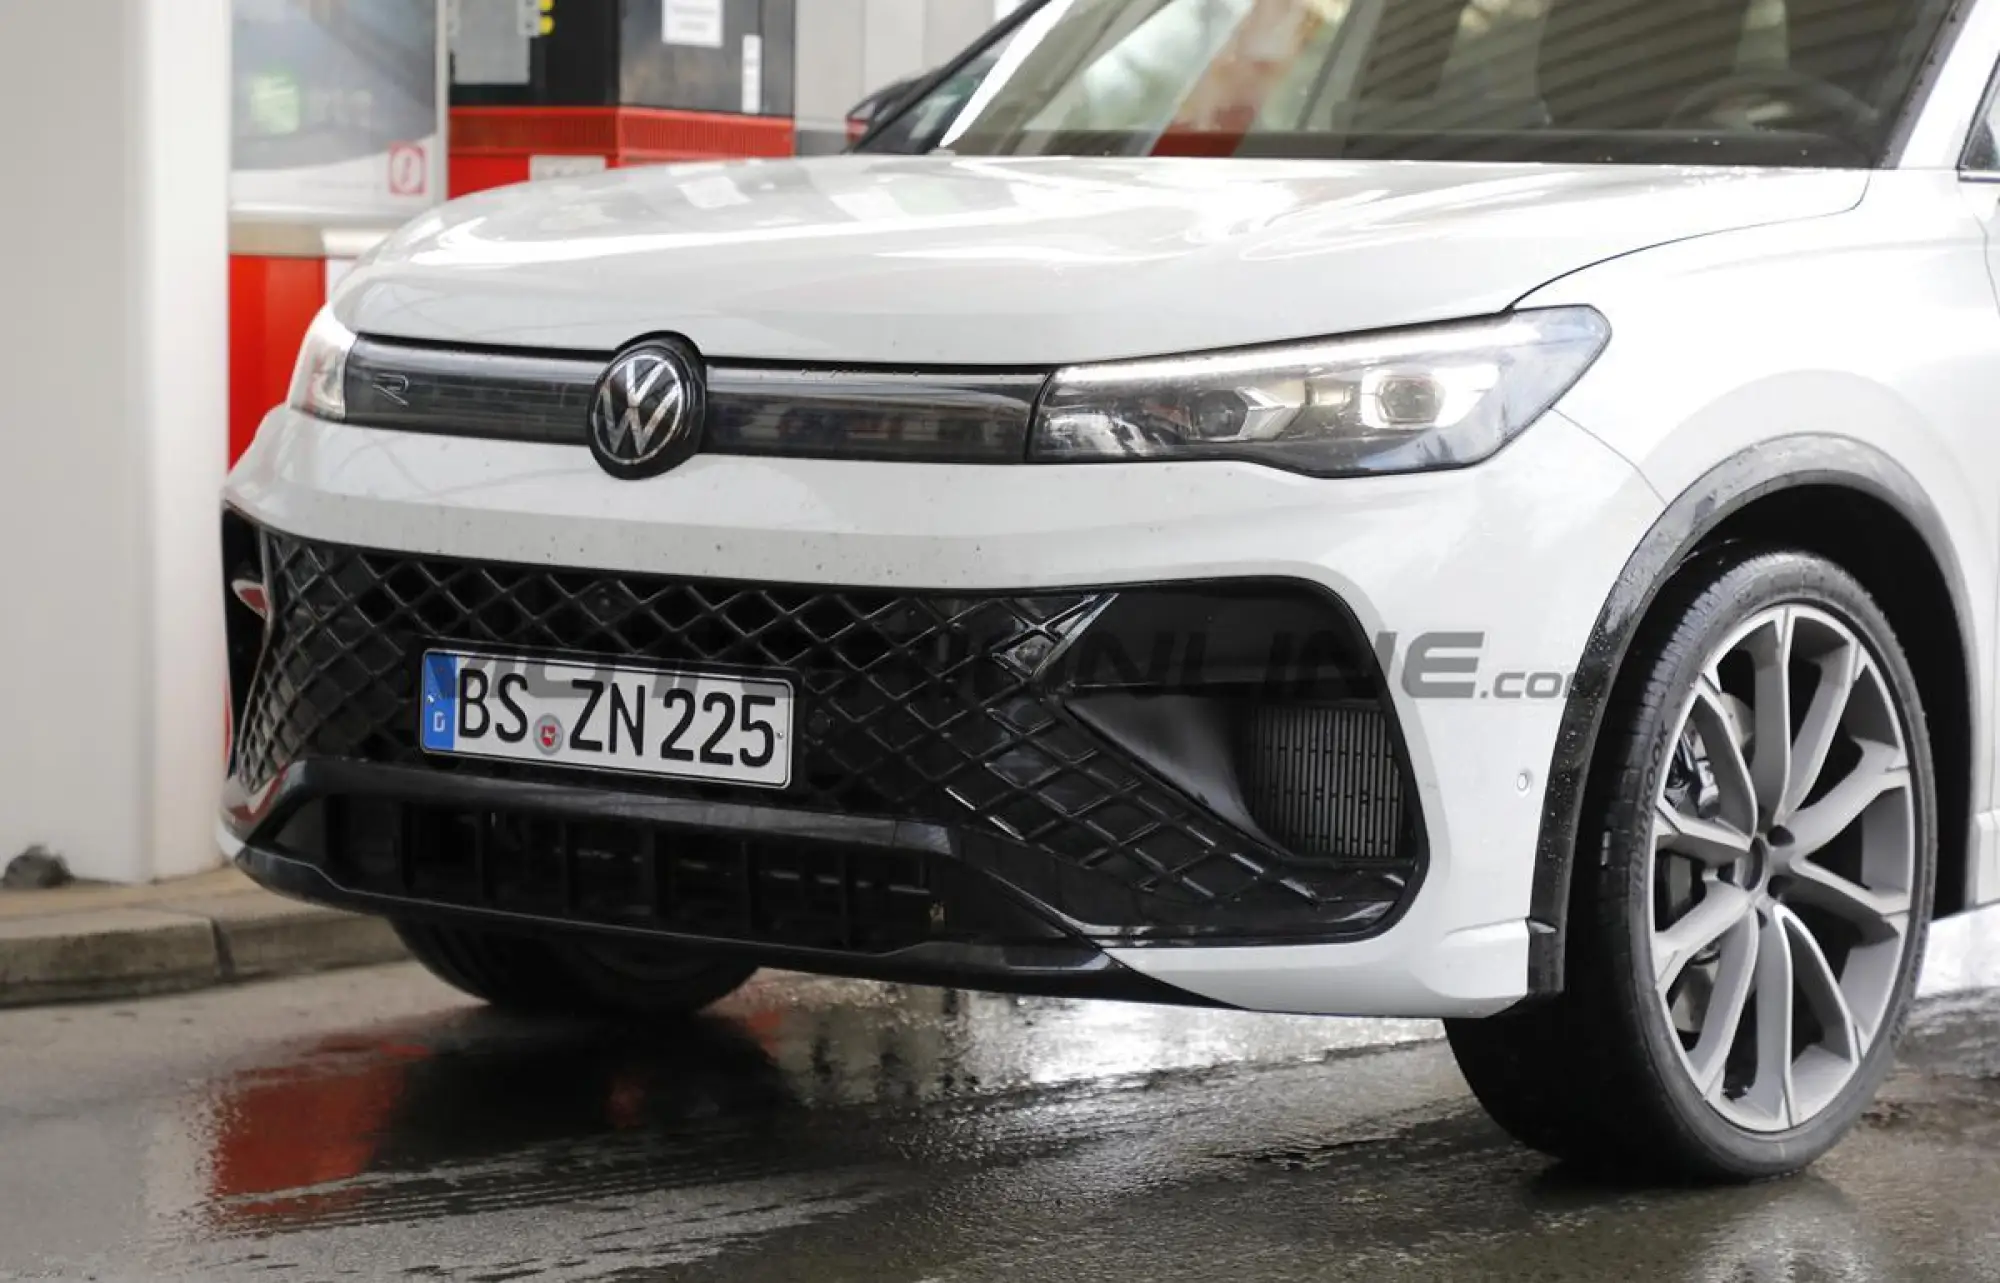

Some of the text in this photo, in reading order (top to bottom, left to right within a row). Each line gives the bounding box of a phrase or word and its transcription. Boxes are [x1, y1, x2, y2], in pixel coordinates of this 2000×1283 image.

[458, 667, 776, 768] BS ZN 225
